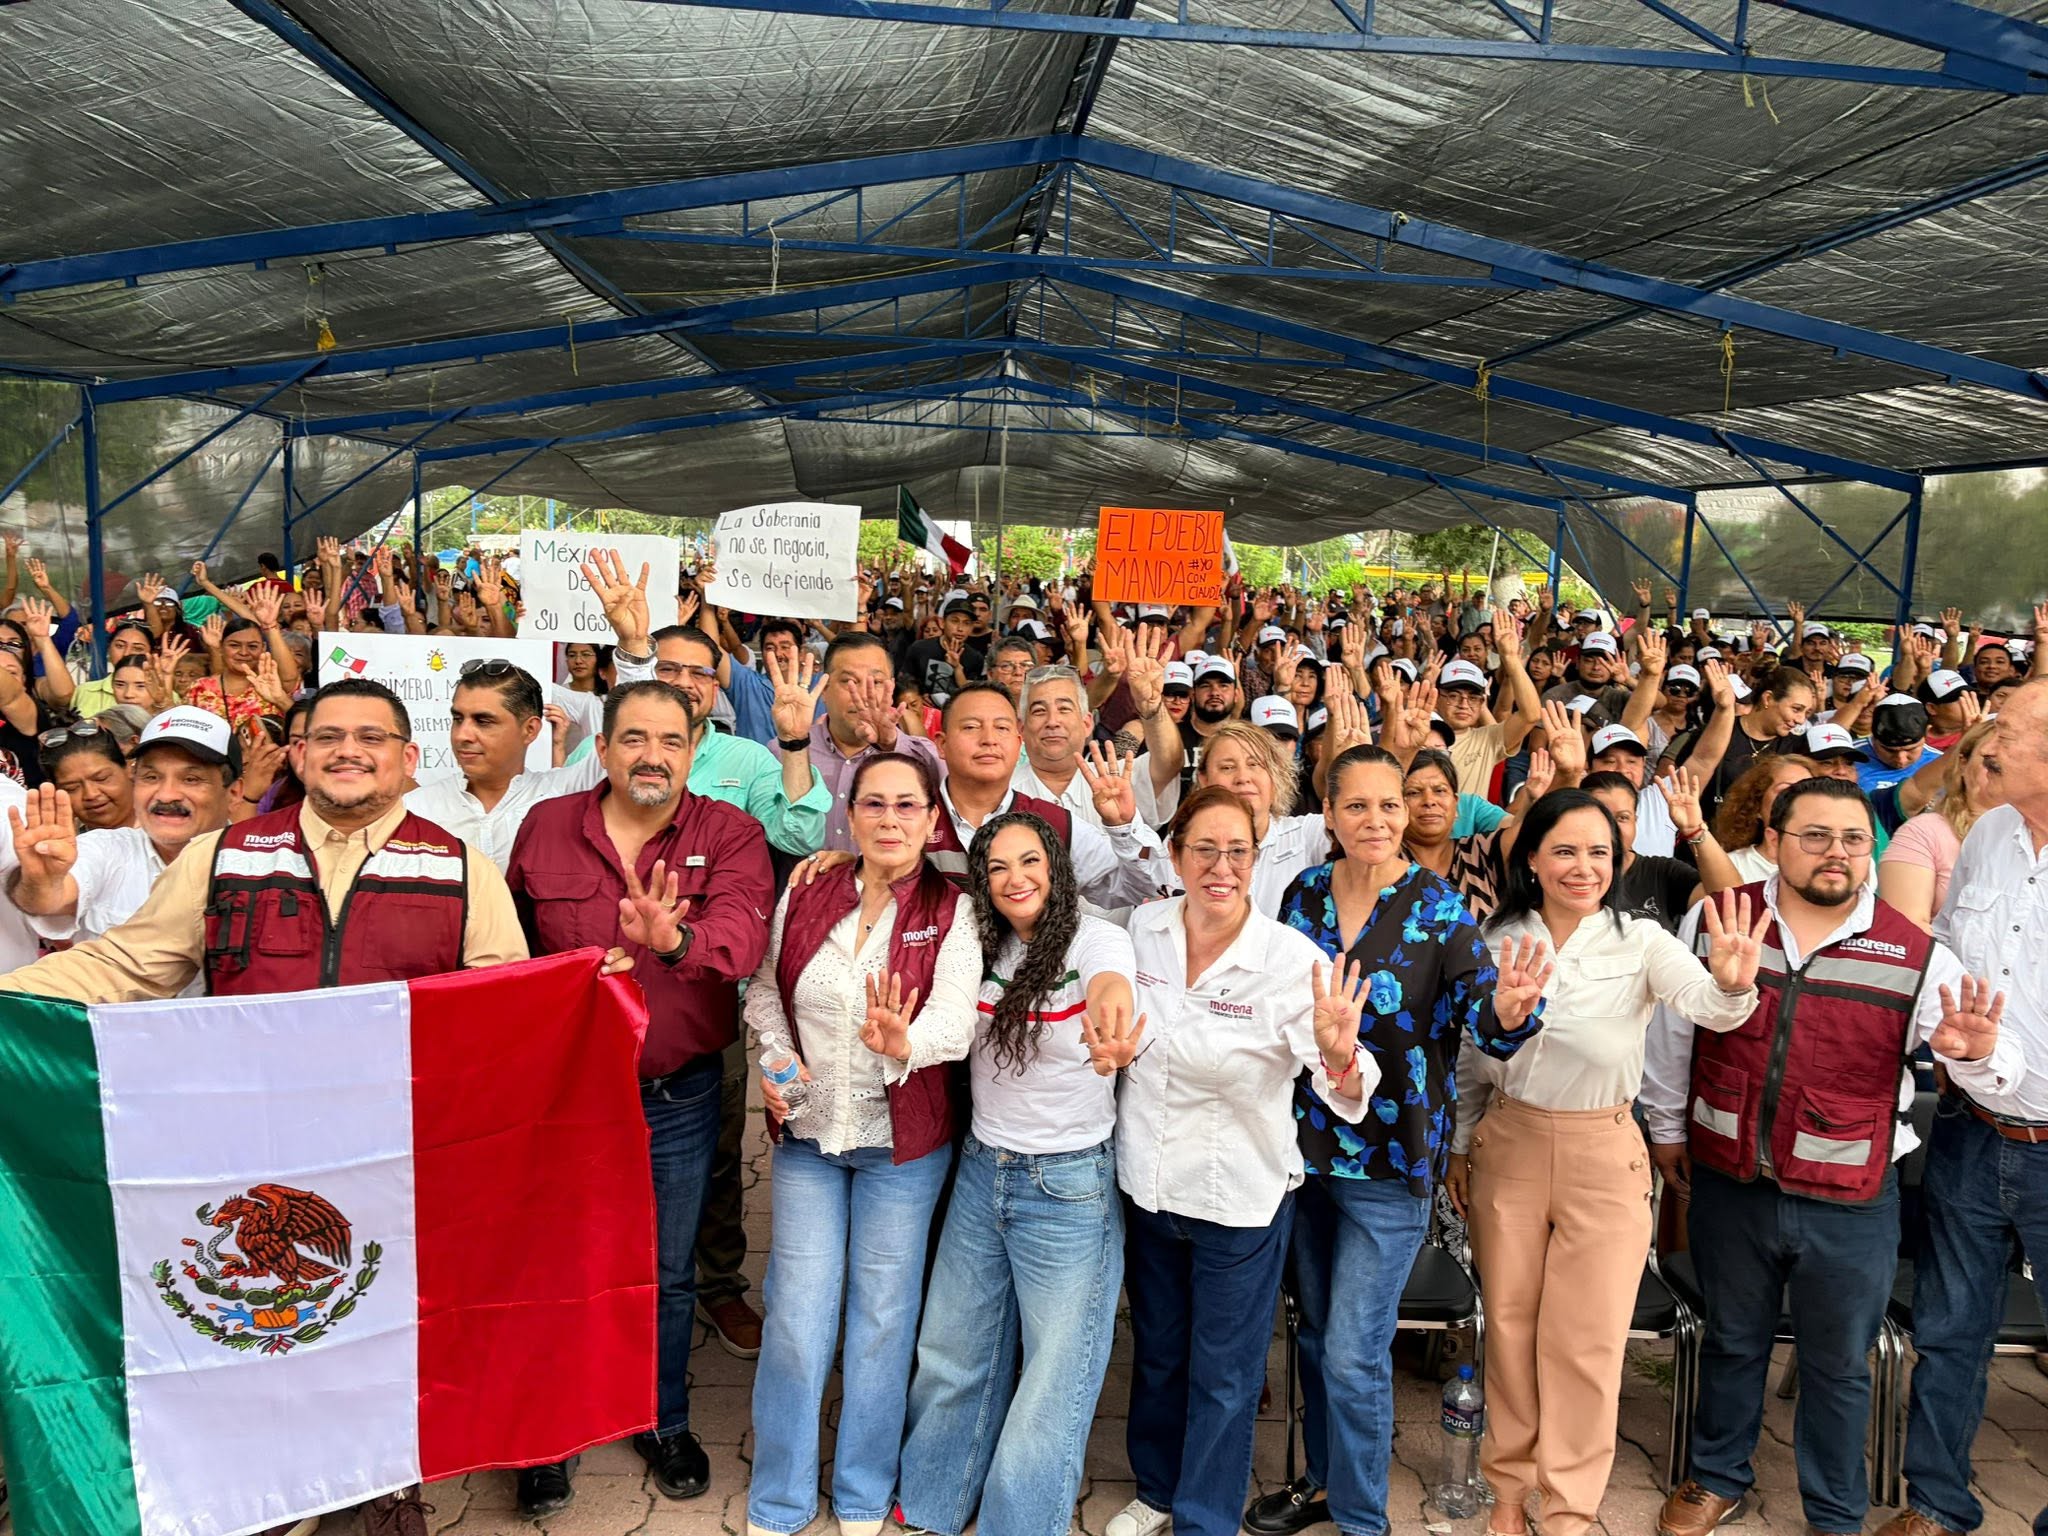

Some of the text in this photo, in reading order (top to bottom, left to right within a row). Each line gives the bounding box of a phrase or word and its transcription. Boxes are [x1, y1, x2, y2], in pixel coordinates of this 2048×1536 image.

[720, 516, 743, 531] La
[1105, 512, 1138, 552] EL
[729, 537, 830, 564] no se negocia,
[763, 561, 833, 597] defiende
[1104, 557, 1185, 601] MANDA
[1186, 572, 1206, 584] CON
[1210, 1000, 1253, 1015] morena
